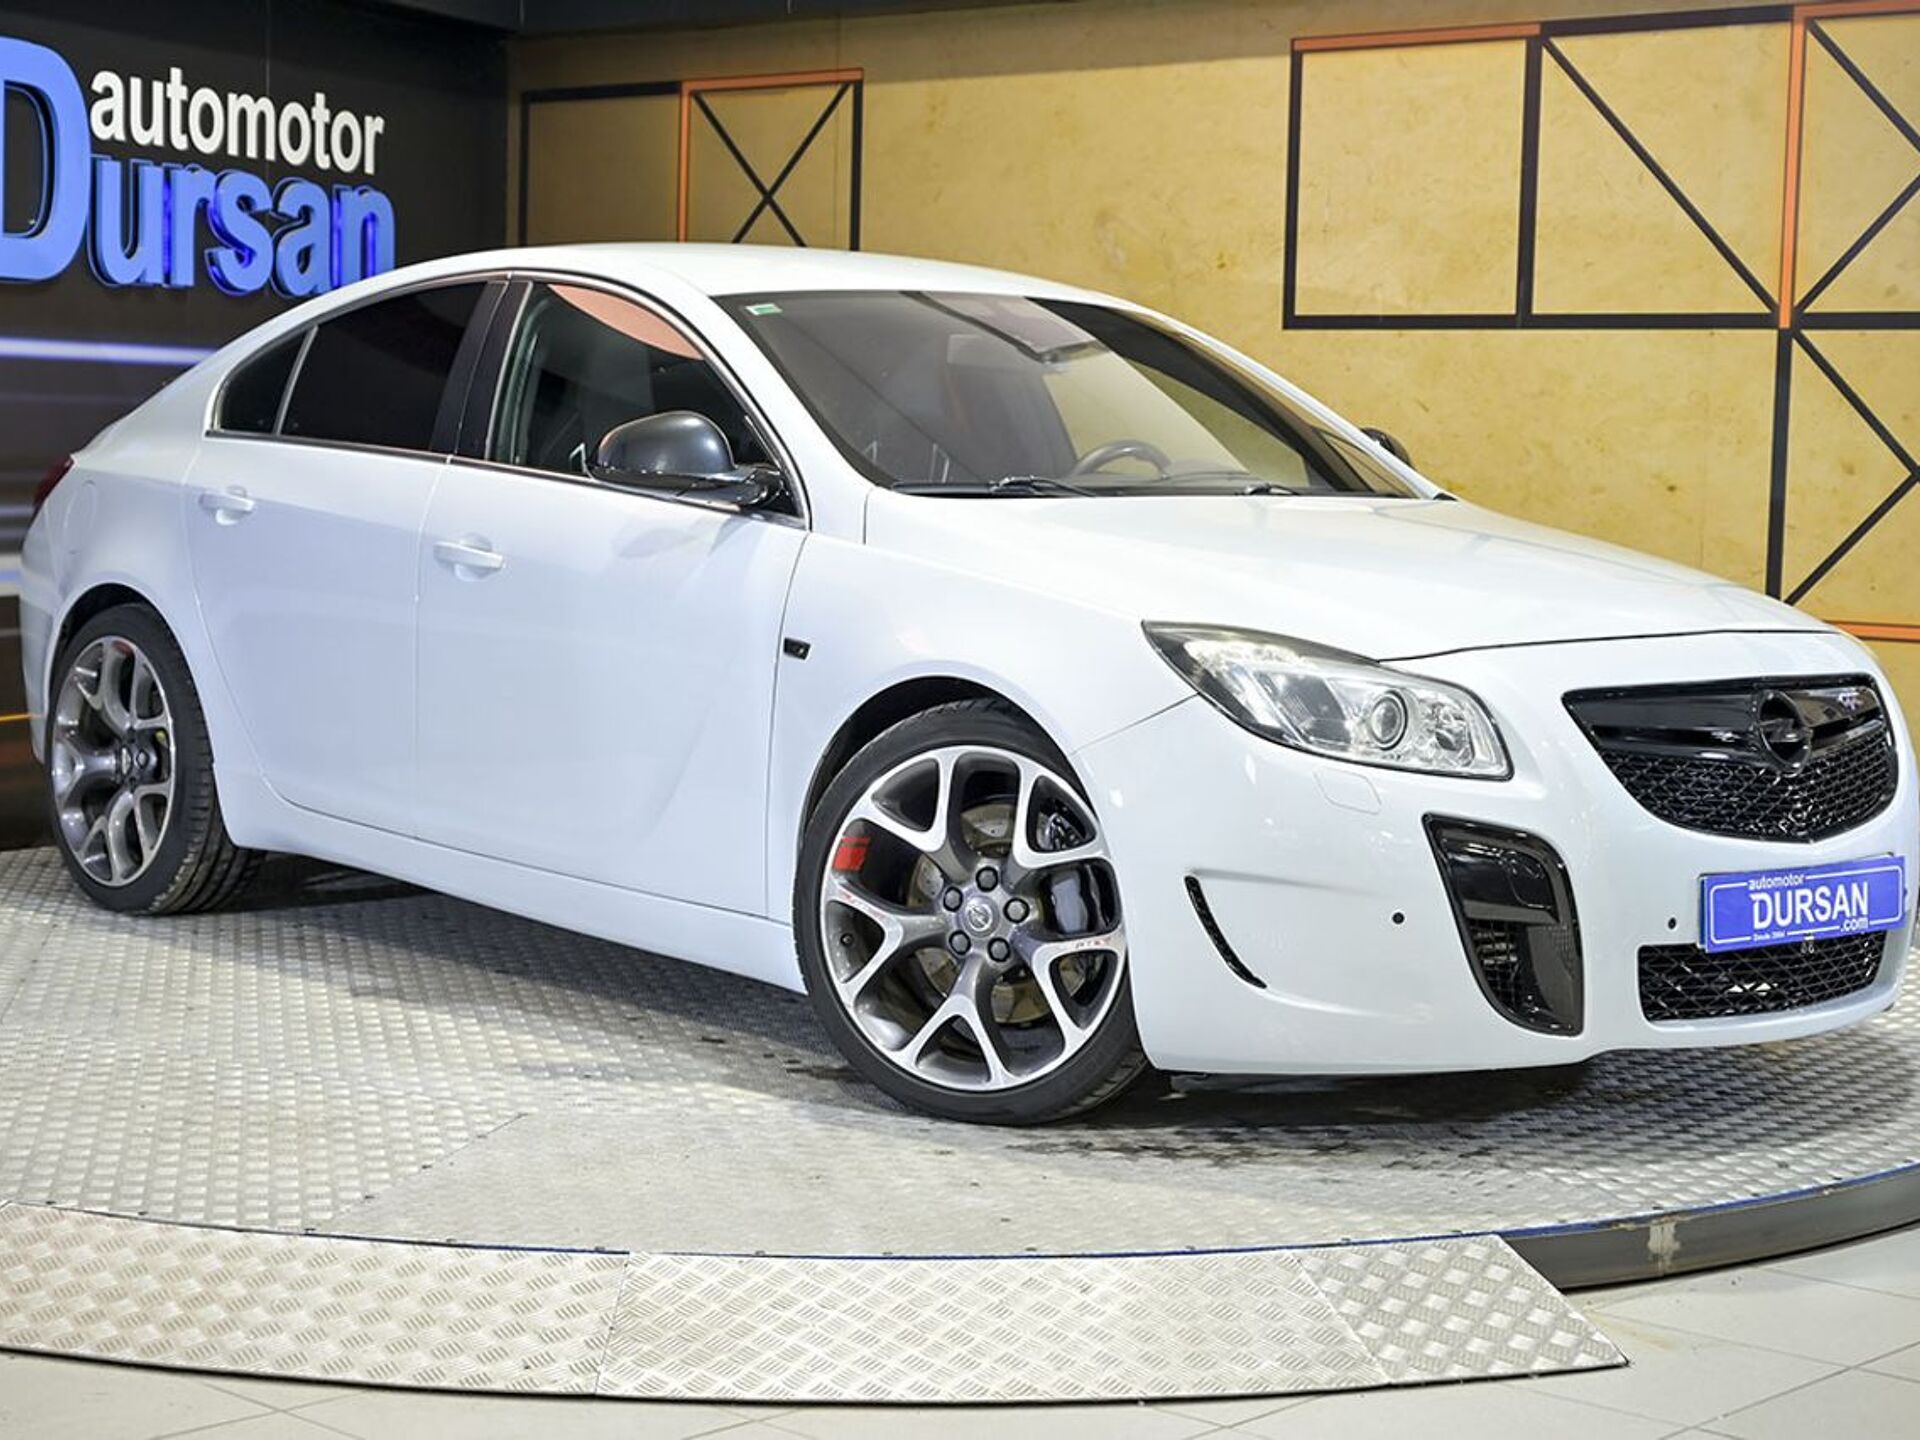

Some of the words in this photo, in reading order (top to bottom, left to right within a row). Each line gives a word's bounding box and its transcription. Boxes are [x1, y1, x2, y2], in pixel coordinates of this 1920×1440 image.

[90, 67, 385, 174] automotor
[0, 36, 396, 298] Dursan
[1748, 873, 1804, 890] automotor
[1749, 881, 1868, 930] DURSAN
[1840, 917, 1868, 932] .com
